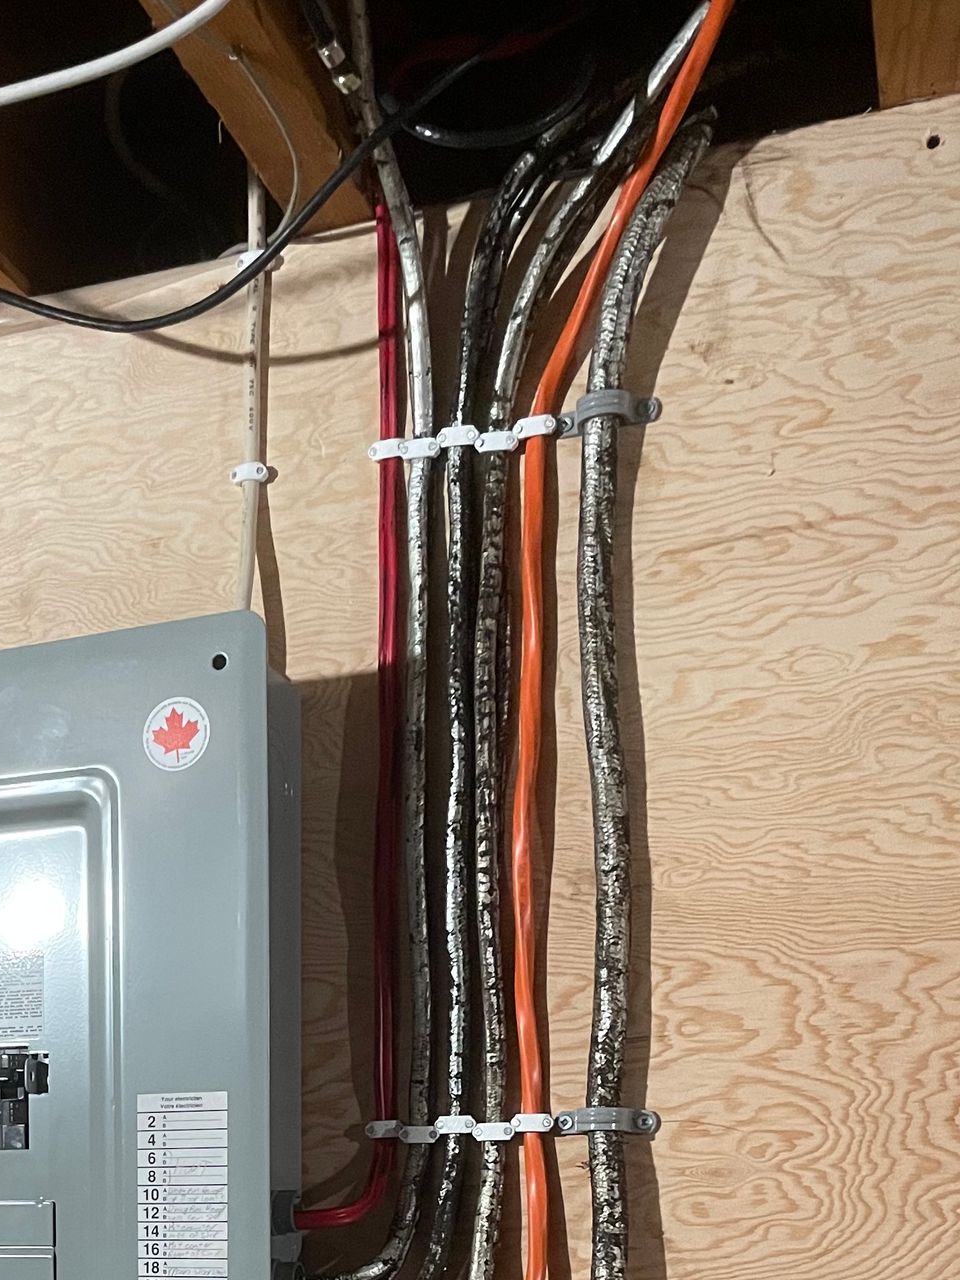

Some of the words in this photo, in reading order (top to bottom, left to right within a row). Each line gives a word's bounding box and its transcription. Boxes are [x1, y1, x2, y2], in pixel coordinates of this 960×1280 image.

[148, 1116, 156, 1128] 2
[148, 1134, 156, 1146] 4
[148, 1152, 156, 1164] 6
[148, 1170, 156, 1182] 8
[144, 1188, 158, 1200] 10
[144, 1206, 160, 1218] 12
[144, 1224, 160, 1238] 14
[144, 1242, 160, 1256] 16
[144, 1262, 160, 1274] 18
